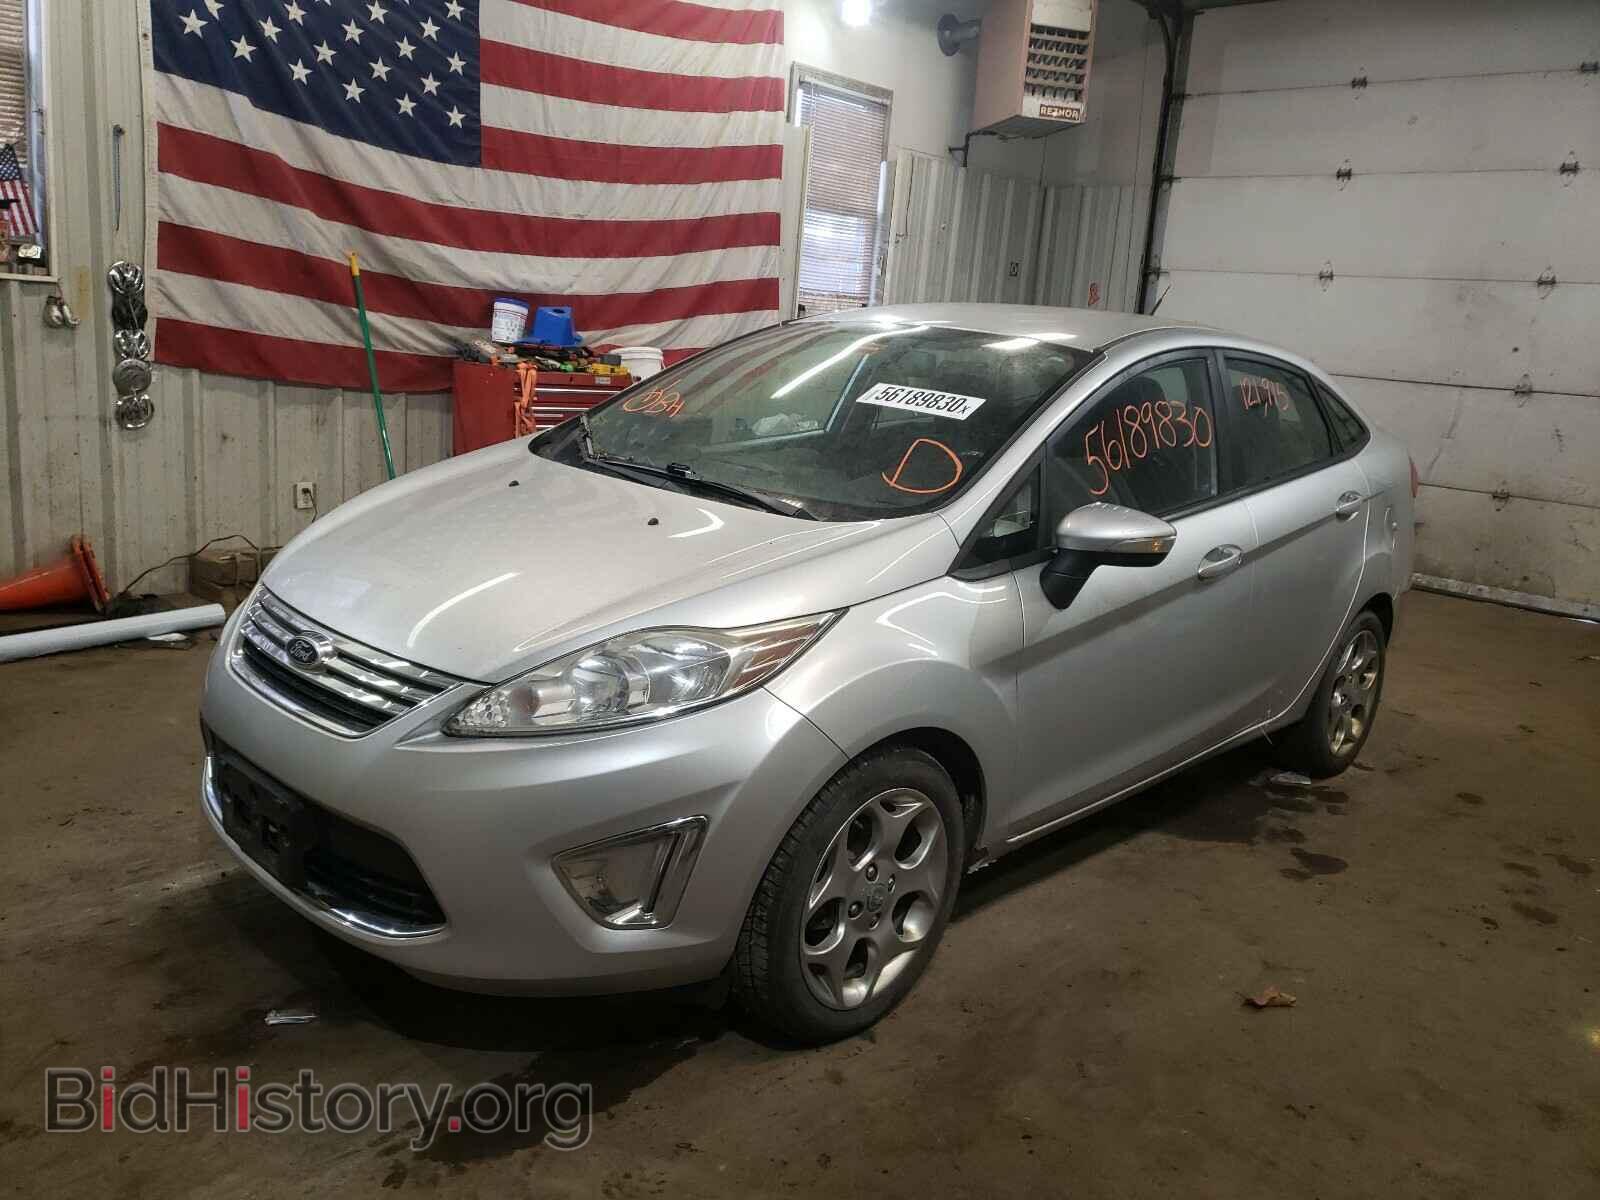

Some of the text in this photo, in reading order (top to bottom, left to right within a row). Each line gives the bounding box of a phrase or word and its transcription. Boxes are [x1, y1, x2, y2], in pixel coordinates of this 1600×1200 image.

[881, 438, 963, 493] D
[1084, 400, 1212, 495] 56189830
[290, 640, 313, 661] Ford
